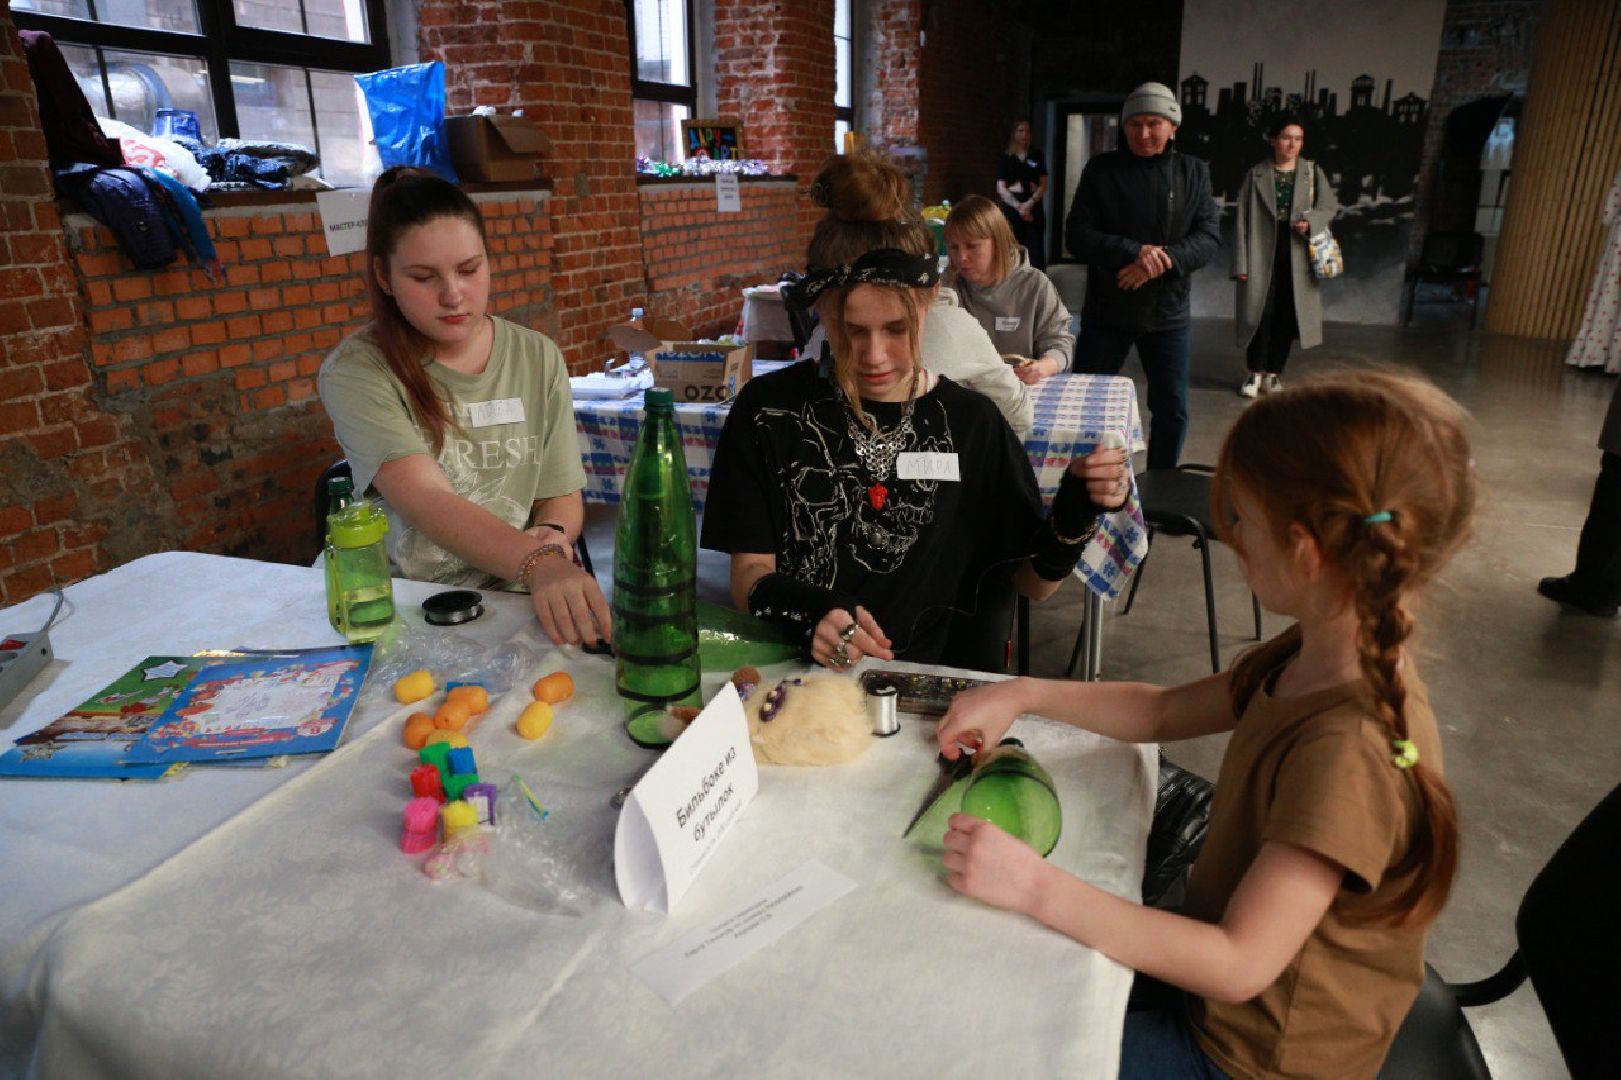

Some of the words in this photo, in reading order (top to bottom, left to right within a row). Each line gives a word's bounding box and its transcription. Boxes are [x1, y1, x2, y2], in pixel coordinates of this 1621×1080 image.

[677, 762, 724, 829] Бильбоке
[725, 747, 735, 767] из
[694, 783, 734, 842] бутылок
